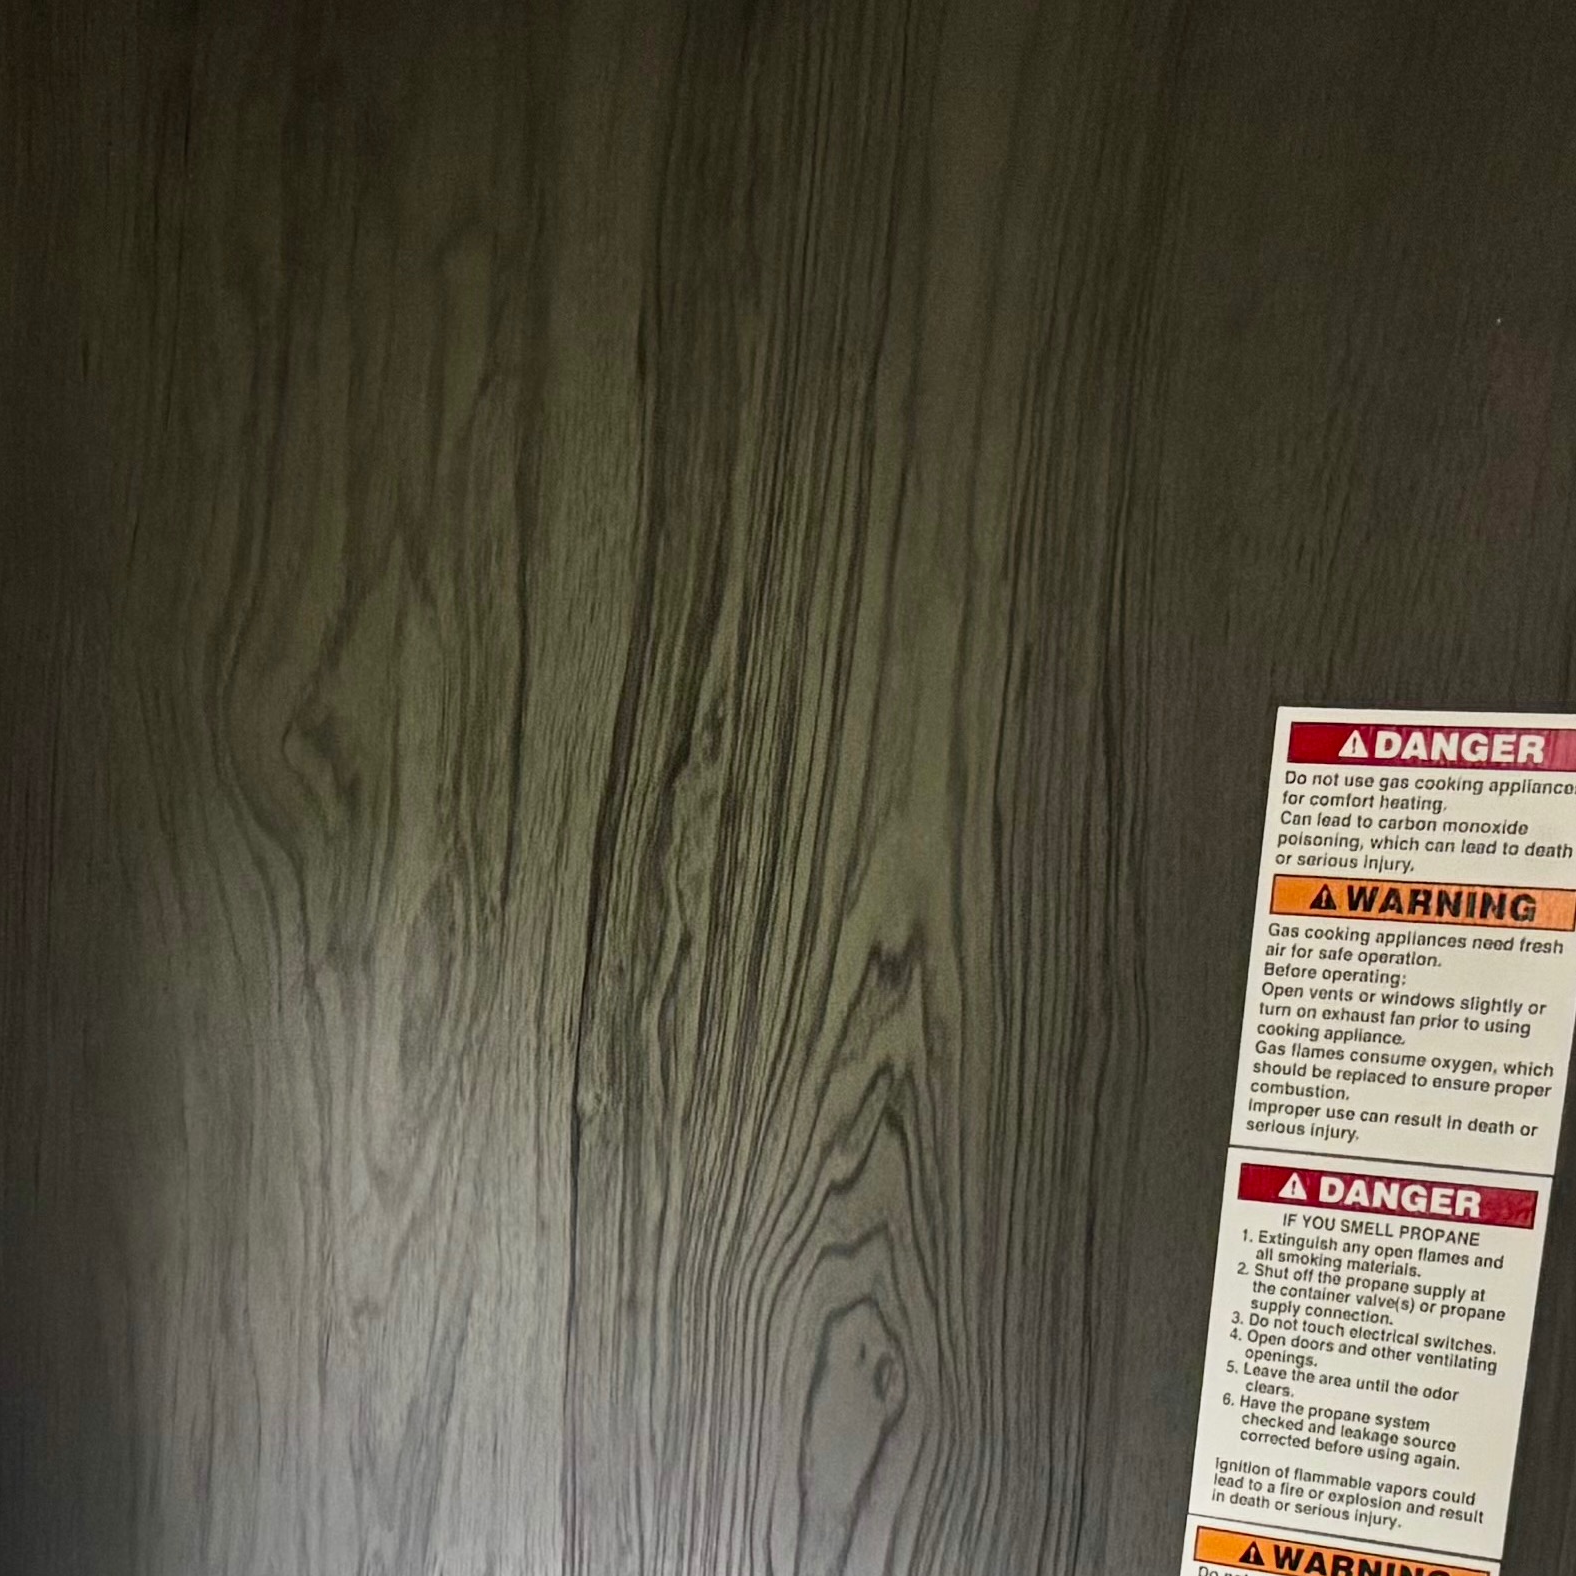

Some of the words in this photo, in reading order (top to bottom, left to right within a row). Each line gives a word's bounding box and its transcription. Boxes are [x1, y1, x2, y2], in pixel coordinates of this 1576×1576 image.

[1374, 730, 1545, 764] DANGER
[1282, 790, 1305, 805] for
[1309, 792, 1374, 808] comfort
[1284, 770, 1306, 784] Do
[1312, 772, 1339, 786] not
[1344, 775, 1374, 787] use
[1378, 777, 1409, 791] gas
[1414, 776, 1483, 795] cooking
[1280, 810, 1311, 825] Can
[1316, 811, 1351, 827] lead
[1357, 814, 1373, 828] to
[1377, 815, 1436, 831] carbon
[1442, 819, 1528, 835] monoxide
[1275, 853, 1292, 864] or
[1296, 852, 1357, 868] serious
[1370, 834, 1419, 850] which
[1424, 840, 1455, 852] can
[1460, 838, 1497, 854] lead
[1502, 842, 1519, 855] to
[1524, 841, 1573, 858] death
[1346, 885, 1537, 923] WARNING
[1265, 942, 1286, 956] air
[1291, 942, 1313, 958] for
[1318, 946, 1353, 961] safe
[1268, 922, 1299, 938] Gas
[1304, 926, 1370, 945] cooking
[1375, 930, 1466, 948] appliances
[1471, 936, 1514, 951] need
[1519, 936, 1563, 954] fresh
[1263, 961, 1317, 979] Before
[1261, 981, 1303, 999] Open
[1309, 987, 1353, 1001] vents
[1358, 991, 1376, 1002] or
[1381, 990, 1455, 1008] windows
[1459, 996, 1523, 1017] slightly
[1527, 1003, 1547, 1015] or
[1254, 1039, 1285, 1055] Gas
[1291, 1042, 1344, 1060] flames
[1349, 1050, 1426, 1067] consume
[1503, 1060, 1553, 1077] which
[1246, 1119, 1305, 1135] serious
[1248, 1097, 1321, 1119] Improper
[1325, 1107, 1355, 1120] use
[1359, 1110, 1389, 1123] can
[1394, 1113, 1441, 1128] result
[1446, 1115, 1462, 1130] in
[1467, 1117, 1514, 1134] death
[1519, 1124, 1538, 1136] or
[1318, 1176, 1482, 1218] DANGER
[1282, 1213, 1297, 1226] IF
[1302, 1214, 1335, 1231] YOU
[1340, 1218, 1393, 1237] SMELL
[1398, 1224, 1480, 1246] PROPANE
[1255, 1247, 1273, 1260] all
[1277, 1251, 1342, 1272] smoking
[1258, 1229, 1337, 1251] Extinguish
[1342, 1242, 1370, 1258] any
[1374, 1245, 1413, 1260] open
[1418, 1247, 1469, 1265] flames
[1473, 1255, 1504, 1269] and
[1249, 1312, 1269, 1327] Do
[1273, 1317, 1298, 1331] not
[1302, 1319, 1344, 1337] touch
[1349, 1326, 1419, 1345] electrical
[1247, 1328, 1286, 1346] Open
[1290, 1334, 1334, 1352] doors
[1337, 1342, 1367, 1356] and
[1370, 1345, 1412, 1361] other
[1416, 1352, 1497, 1375] ventilating
[1215, 1456, 1270, 1476] Ignition
[1274, 1466, 1289, 1479] of
[1294, 1467, 1371, 1490] flammable
[1376, 1481, 1427, 1498] vapors
[1432, 1489, 1476, 1505] could
[1211, 1488, 1224, 1502] in
[1229, 1491, 1269, 1508] death
[1274, 1500, 1290, 1511] or
[1294, 1502, 1349, 1520] serious
[1213, 1472, 1244, 1488] lead
[1248, 1478, 1262, 1491] to
[1266, 1482, 1275, 1493] a
[1279, 1481, 1304, 1497] fire
[1307, 1488, 1324, 1500] or
[1327, 1491, 1401, 1511] explosion
[1405, 1502, 1435, 1516] and
[1438, 1507, 1483, 1524] result
